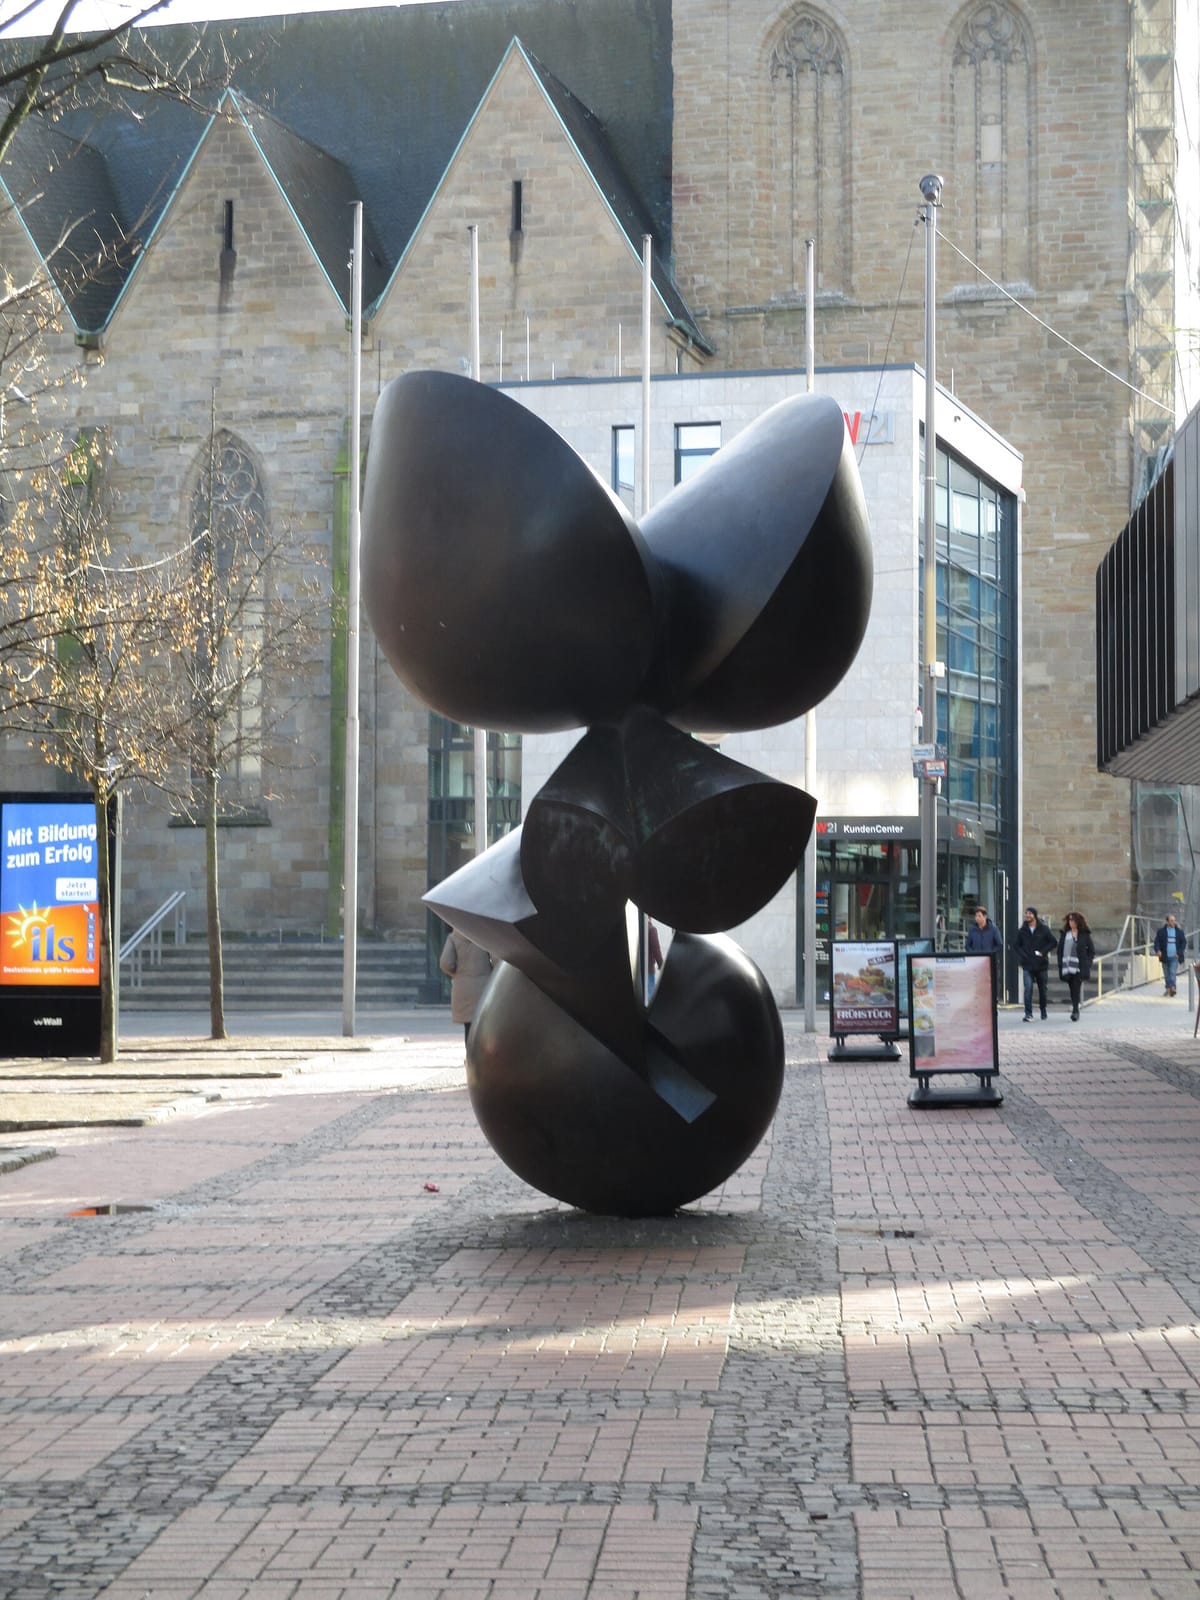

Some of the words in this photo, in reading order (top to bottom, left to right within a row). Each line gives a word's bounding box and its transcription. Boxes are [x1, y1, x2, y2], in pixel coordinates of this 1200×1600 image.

[7, 827, 33, 848] Mit
[38, 822, 97, 842] Bildung
[843, 824, 904, 834] KundenCenter
[6, 851, 40, 869] zum
[45, 843, 92, 864] Erfolg
[31, 924, 76, 961] ils
[42, 1017, 63, 1026] Wall
[836, 1008, 892, 1019] FRÜHSTÜCK
